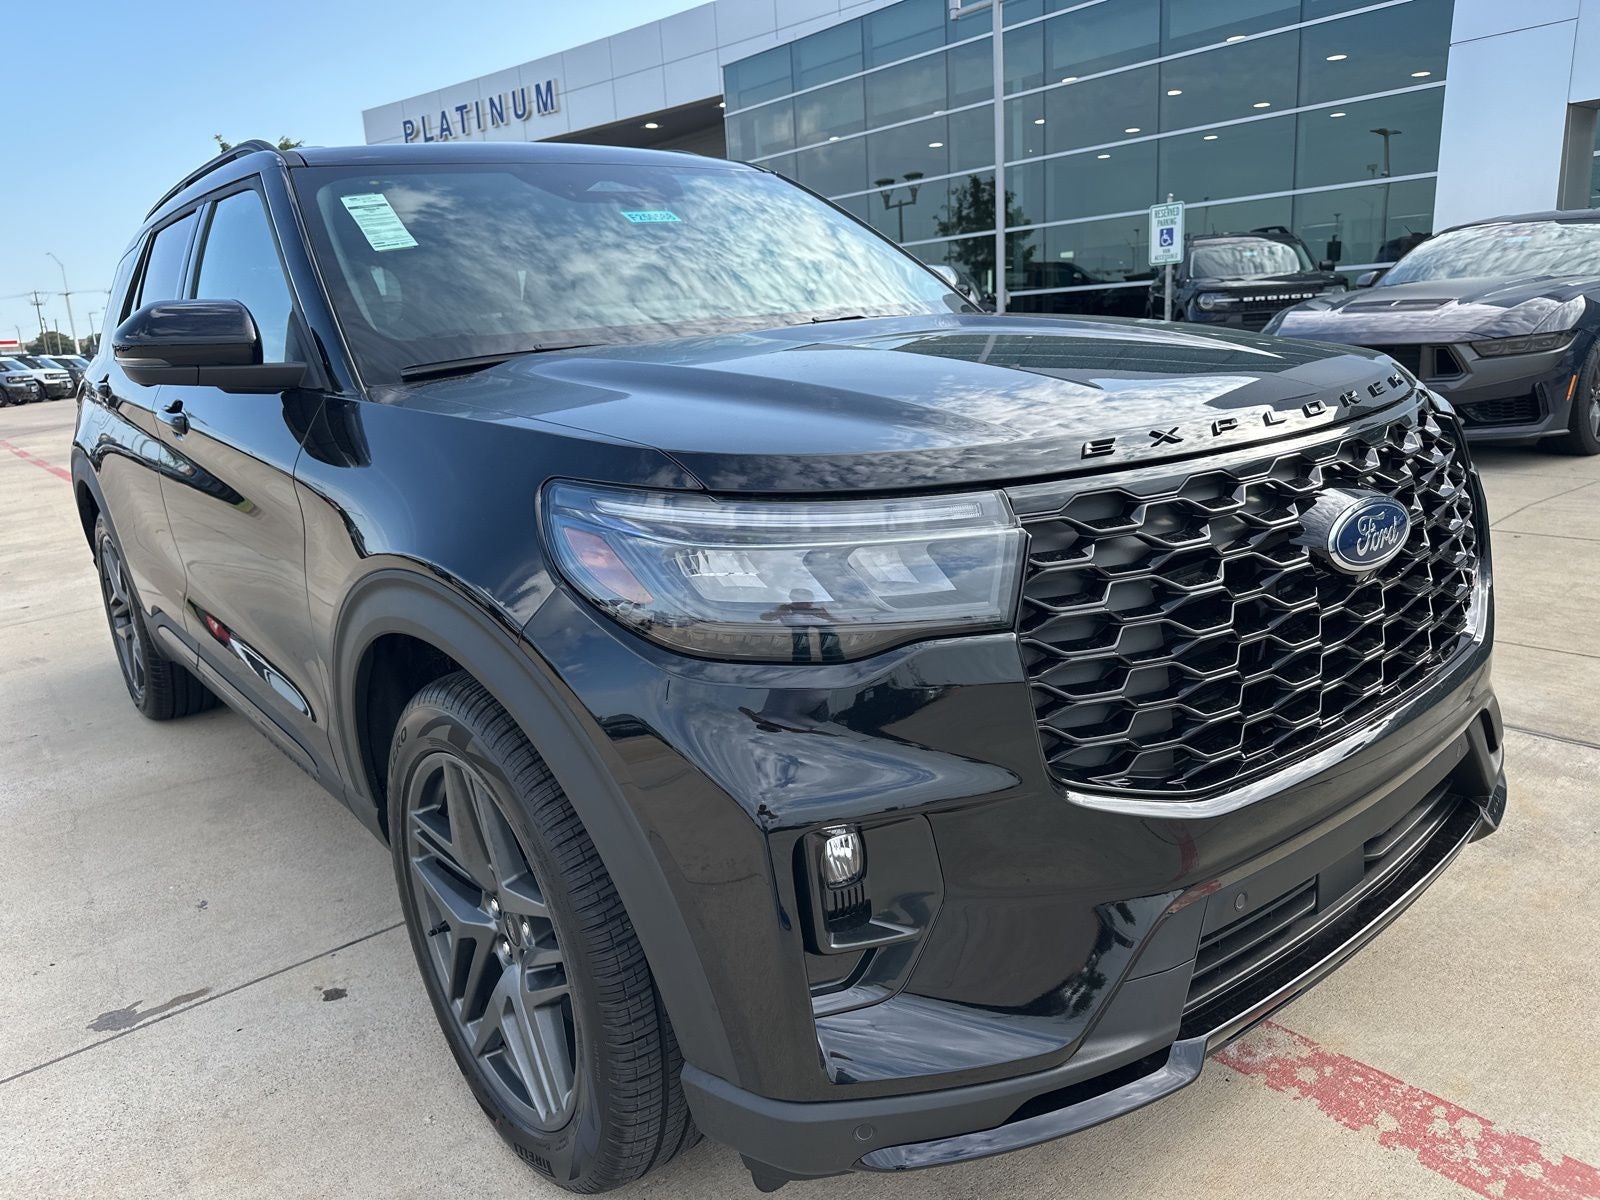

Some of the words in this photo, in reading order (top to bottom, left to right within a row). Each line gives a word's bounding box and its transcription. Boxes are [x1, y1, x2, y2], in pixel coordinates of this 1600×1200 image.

[402, 79, 559, 143] PLATINUM
[1155, 206, 1179, 219] RESERVED
[1242, 293, 1313, 302] BRONCO
[1081, 372, 1405, 460] EXPLORER
[1356, 511, 1399, 557] Ford
[513, 1142, 556, 1178] PIRELLI
